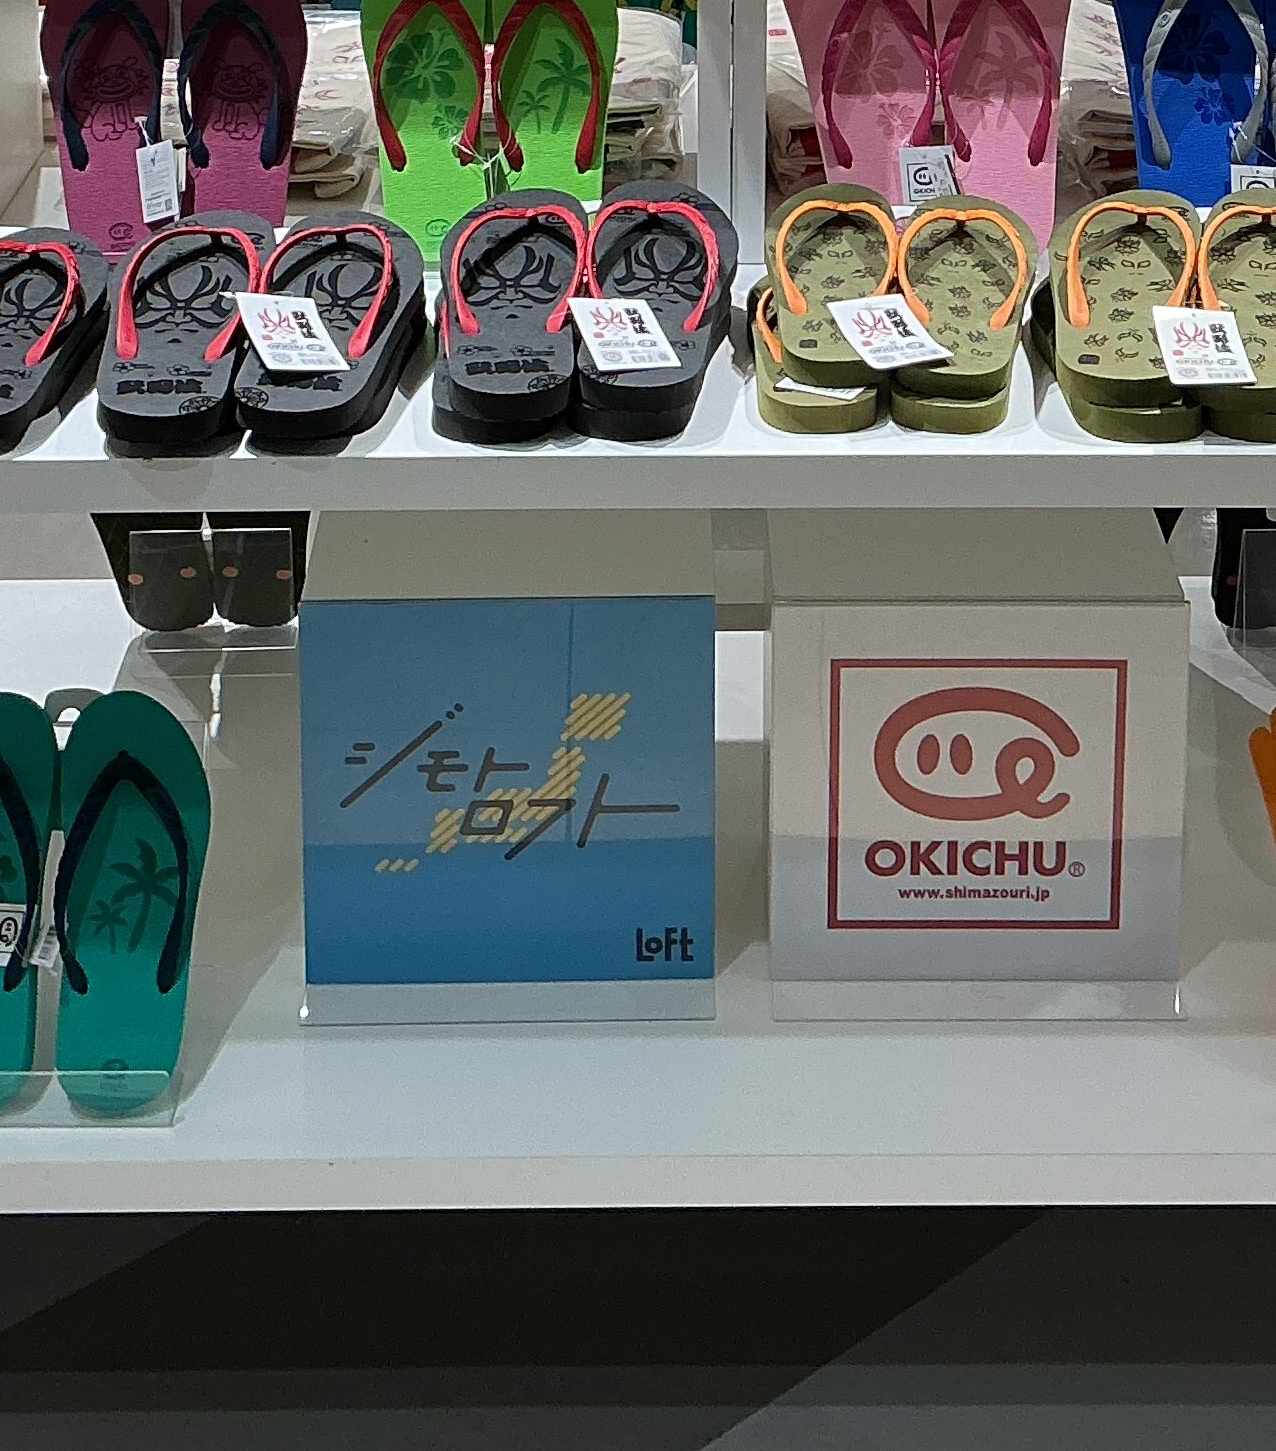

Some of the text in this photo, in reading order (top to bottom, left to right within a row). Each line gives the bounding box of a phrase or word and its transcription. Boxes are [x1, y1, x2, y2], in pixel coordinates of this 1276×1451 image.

[340, 702, 530, 809] ジモト
[459, 773, 681, 861] ロフト
[864, 839, 1068, 878] OKICHU
[898, 884, 1051, 902] www.shimazouri.jp
